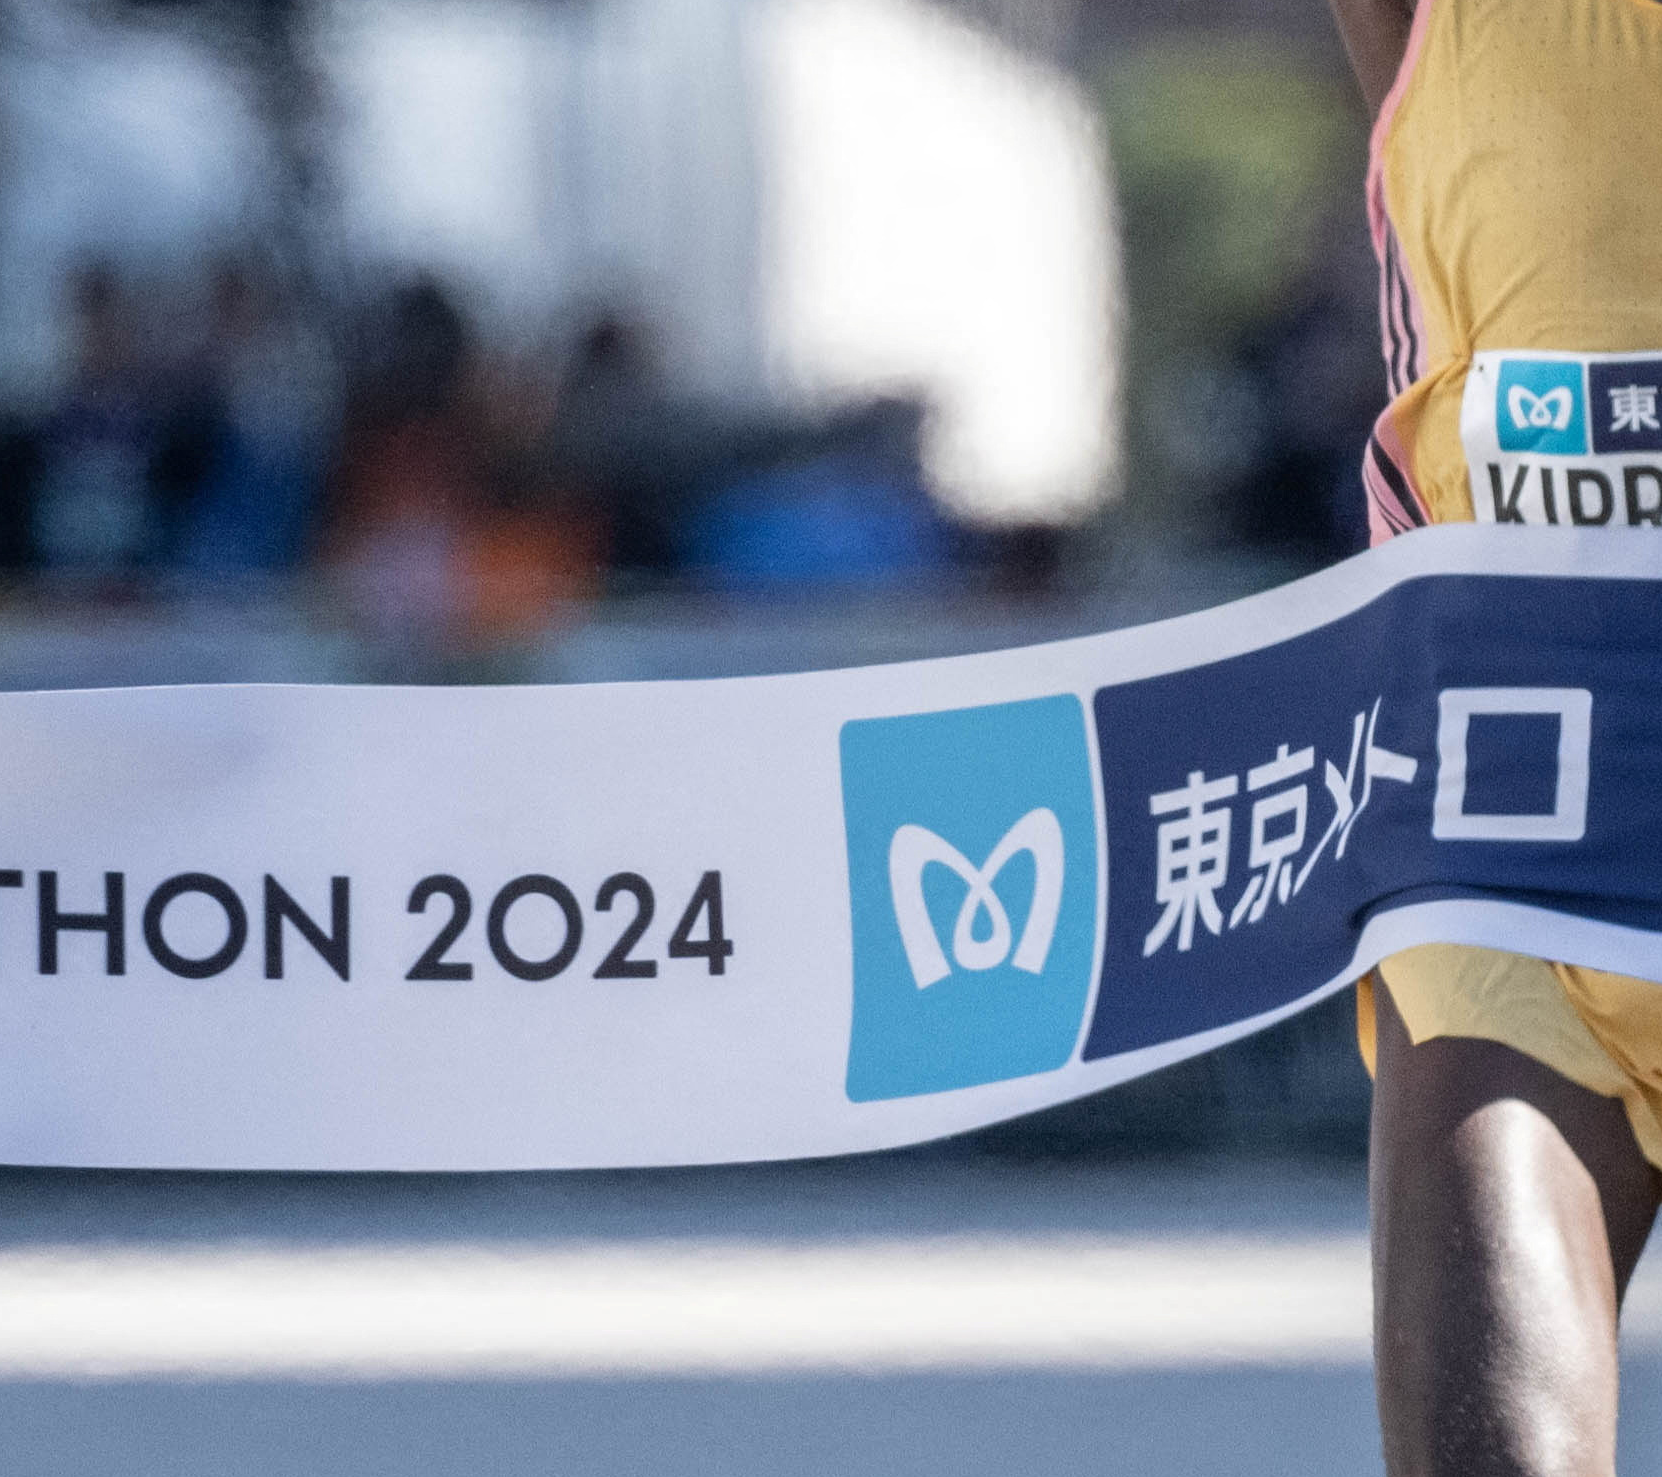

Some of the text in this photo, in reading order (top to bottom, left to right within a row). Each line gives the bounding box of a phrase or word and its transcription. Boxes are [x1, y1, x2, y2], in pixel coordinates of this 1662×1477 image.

[1143, 687, 1593, 958] 東京メトロ
[405, 870, 733, 982] 2024
